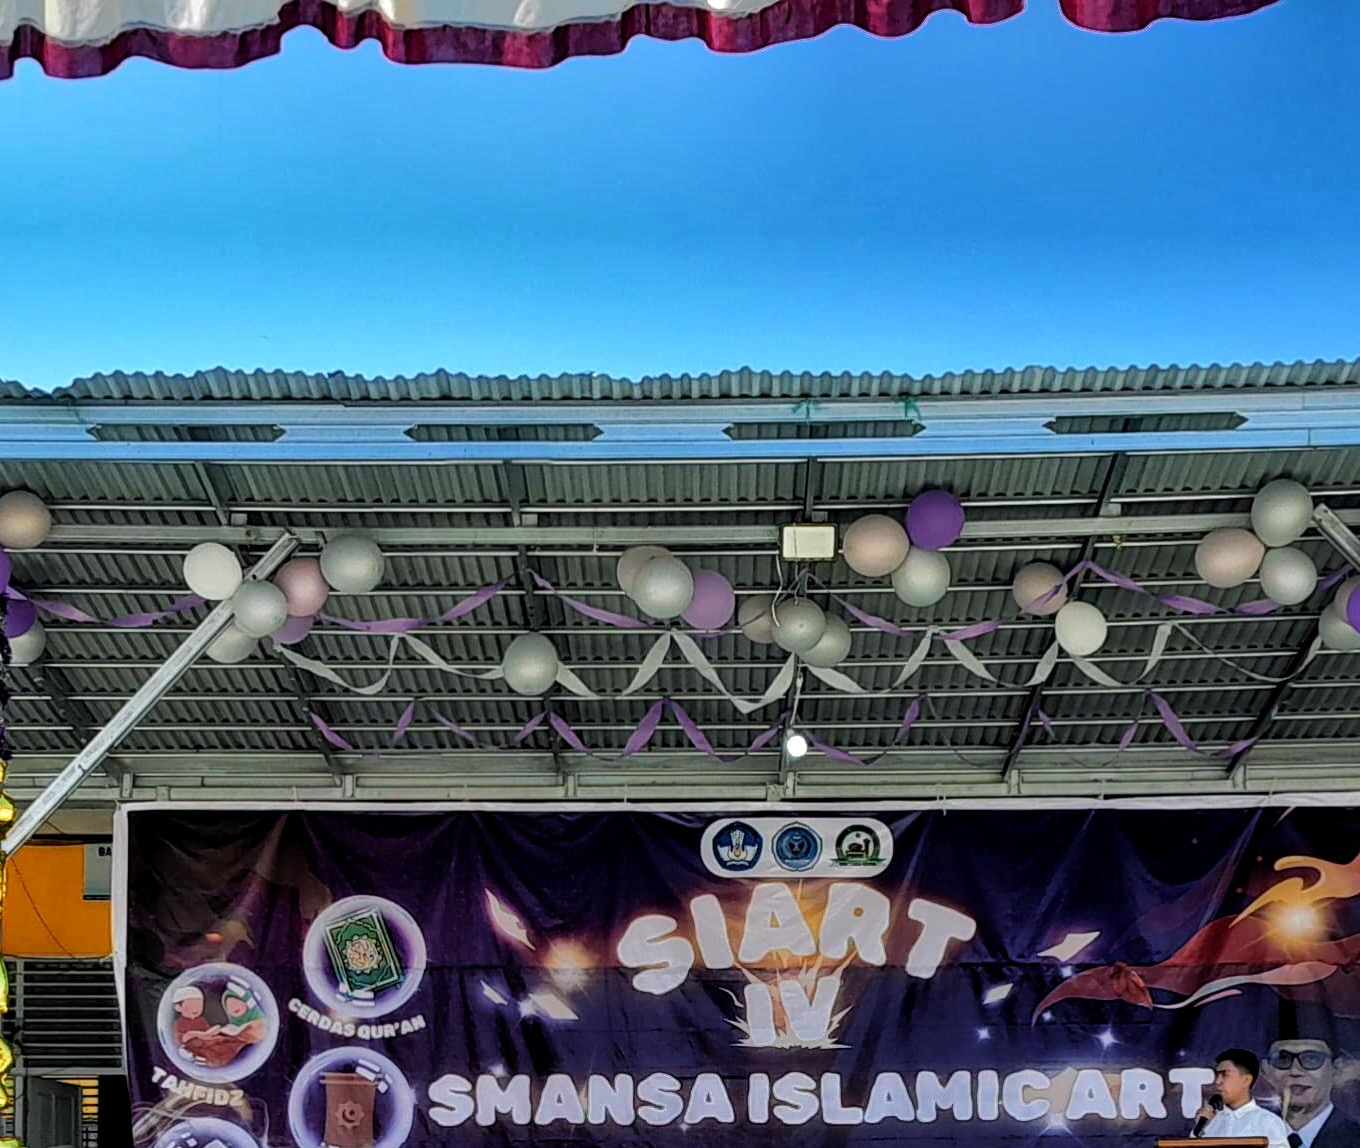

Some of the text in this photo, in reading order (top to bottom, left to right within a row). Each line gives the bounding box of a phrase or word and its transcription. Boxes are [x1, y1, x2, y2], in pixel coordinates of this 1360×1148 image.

[617, 882, 977, 995] SIART
[289, 998, 426, 1040] CERDAS QUR'AN
[744, 976, 840, 1044] IV
[151, 1066, 244, 1107] TAHFIDZ
[428, 1068, 1215, 1127] SMANSA ISLAMIC ART
